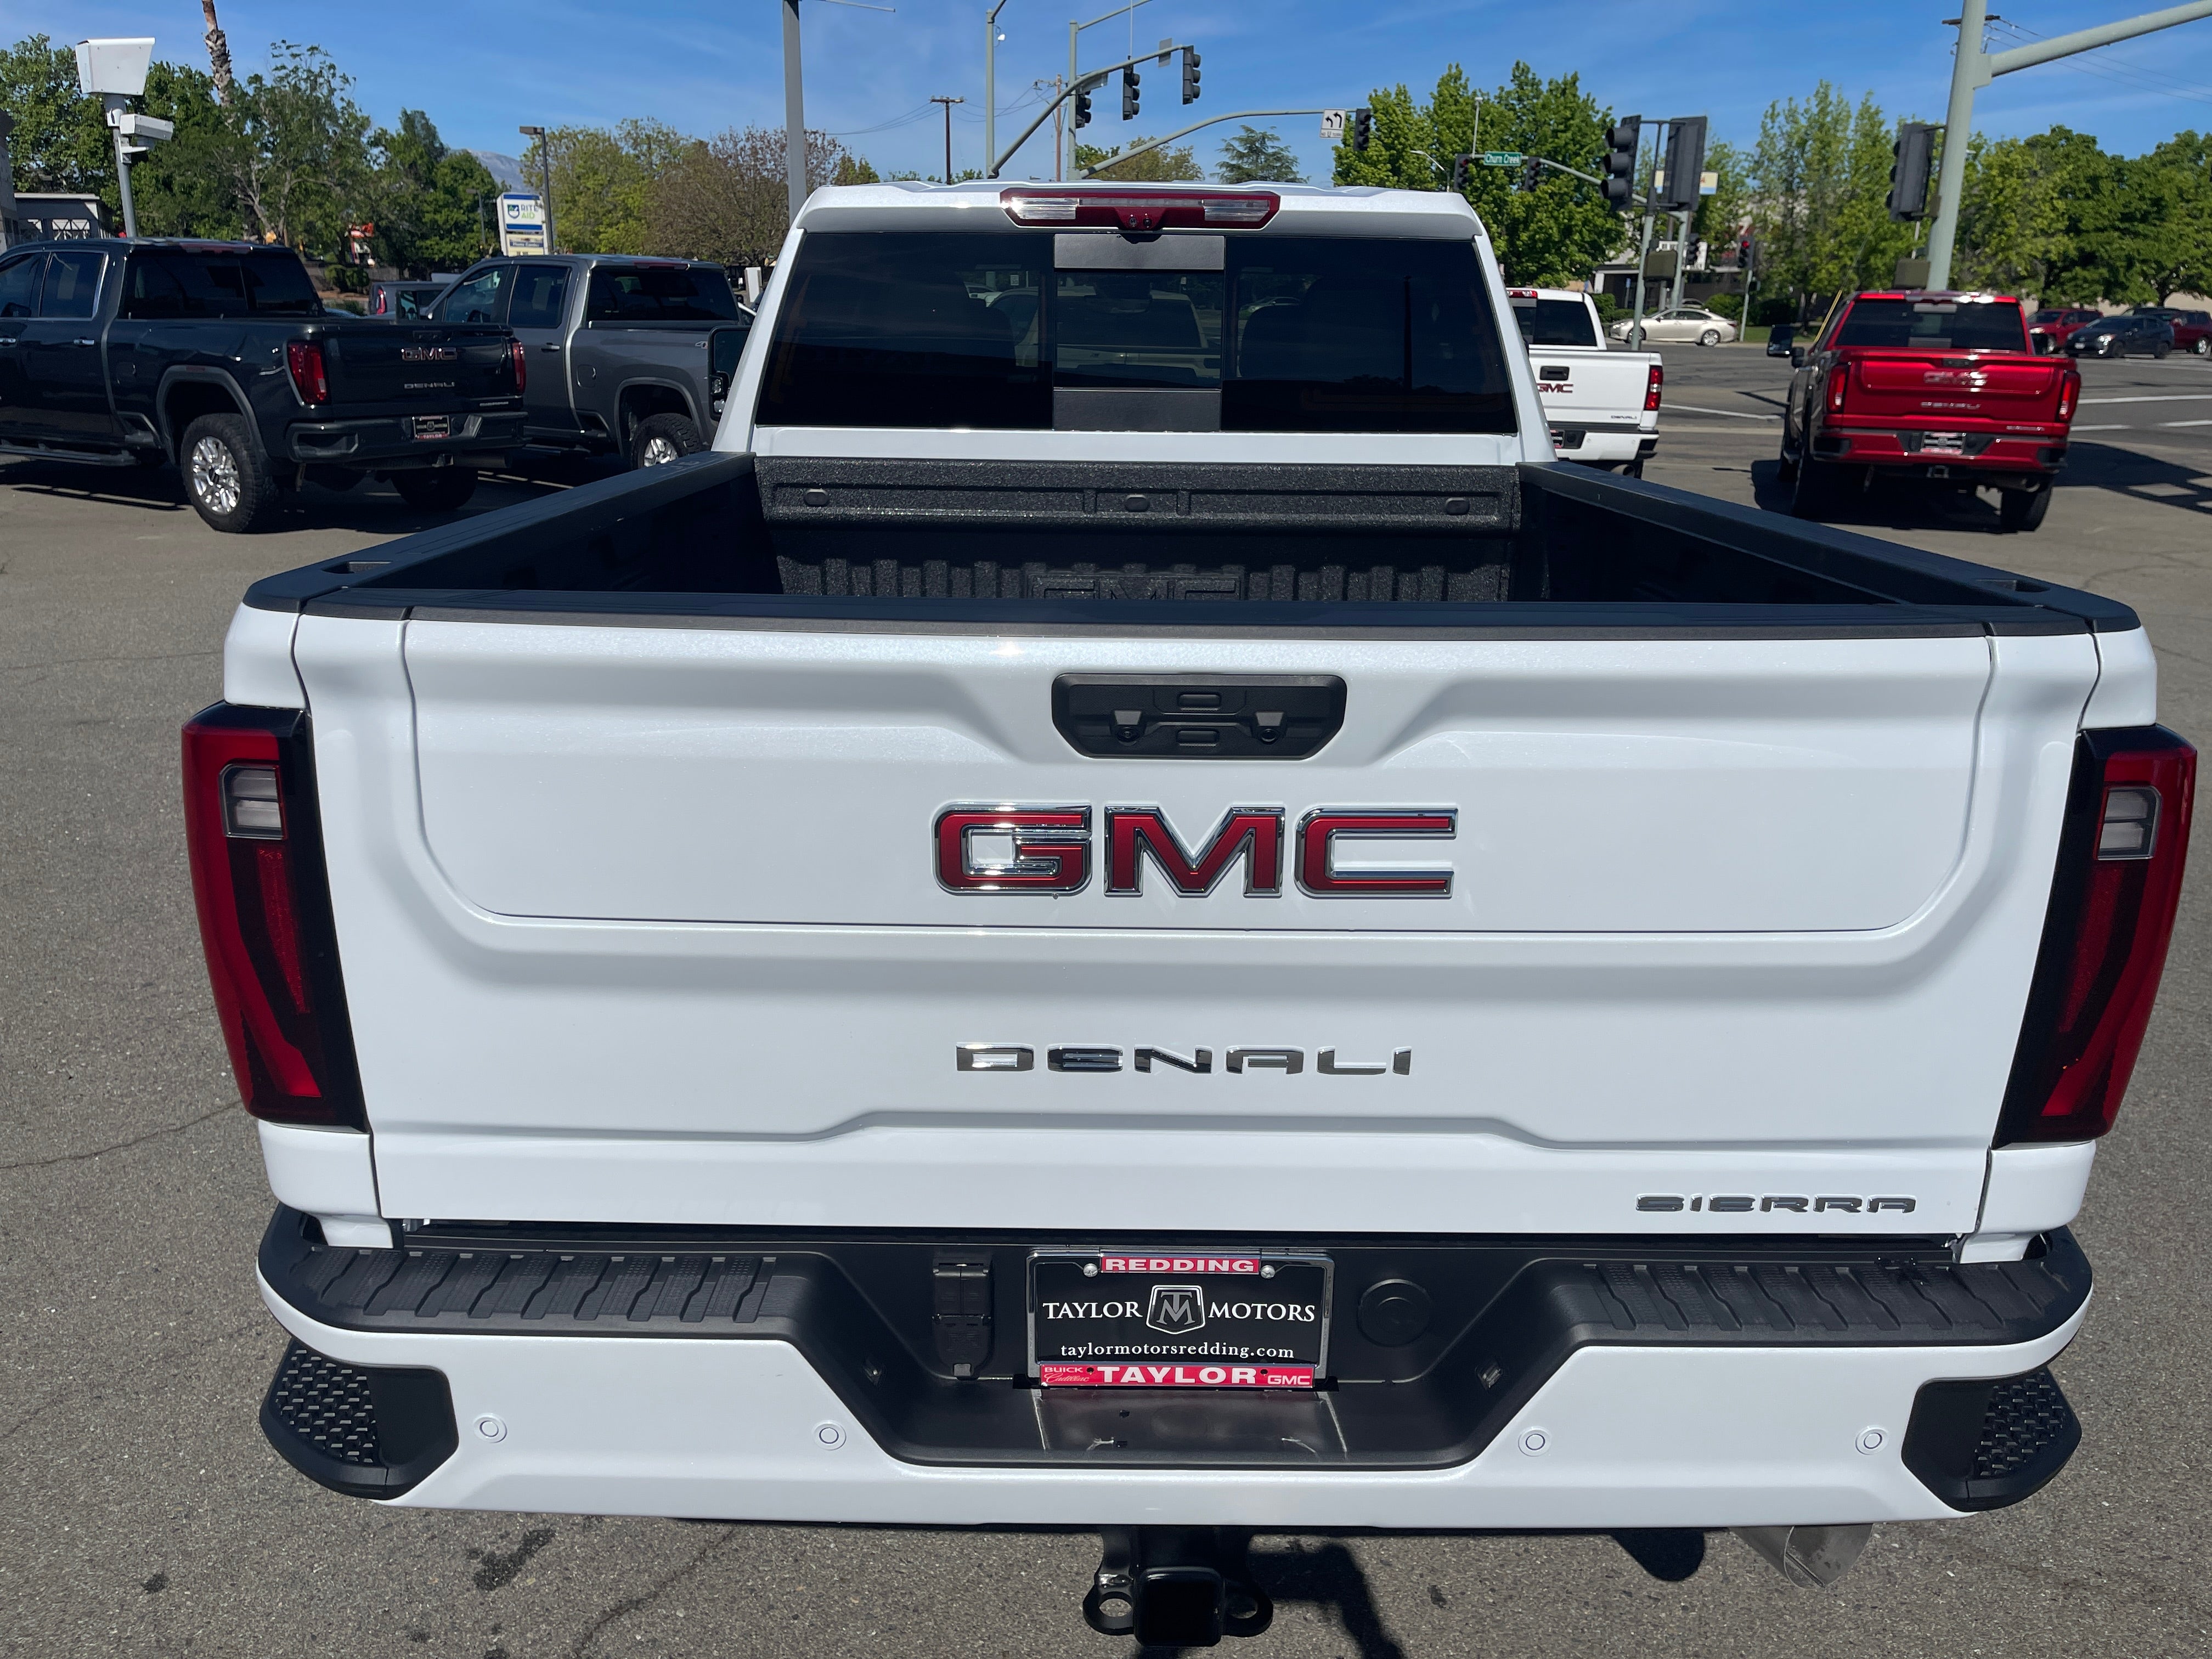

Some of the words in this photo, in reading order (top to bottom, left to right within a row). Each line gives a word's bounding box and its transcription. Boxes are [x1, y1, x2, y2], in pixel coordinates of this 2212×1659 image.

[402, 347, 458, 361] GMC
[934, 803, 1458, 898] GMC
[956, 1045, 1412, 1075] DENALI
[1636, 1194, 1916, 1213] SIERRA
[1105, 1260, 1254, 1272] REDDING
[1042, 1301, 1143, 1319] TAYLOR
[1208, 1302, 1315, 1322] MOTORS
[1061, 1342, 1294, 1358] taylormotorsredding.com
[1044, 1373, 1090, 1383] Cadillac
[1097, 1367, 1256, 1384] TAYLOR
[1267, 1375, 1310, 1385] GMC
